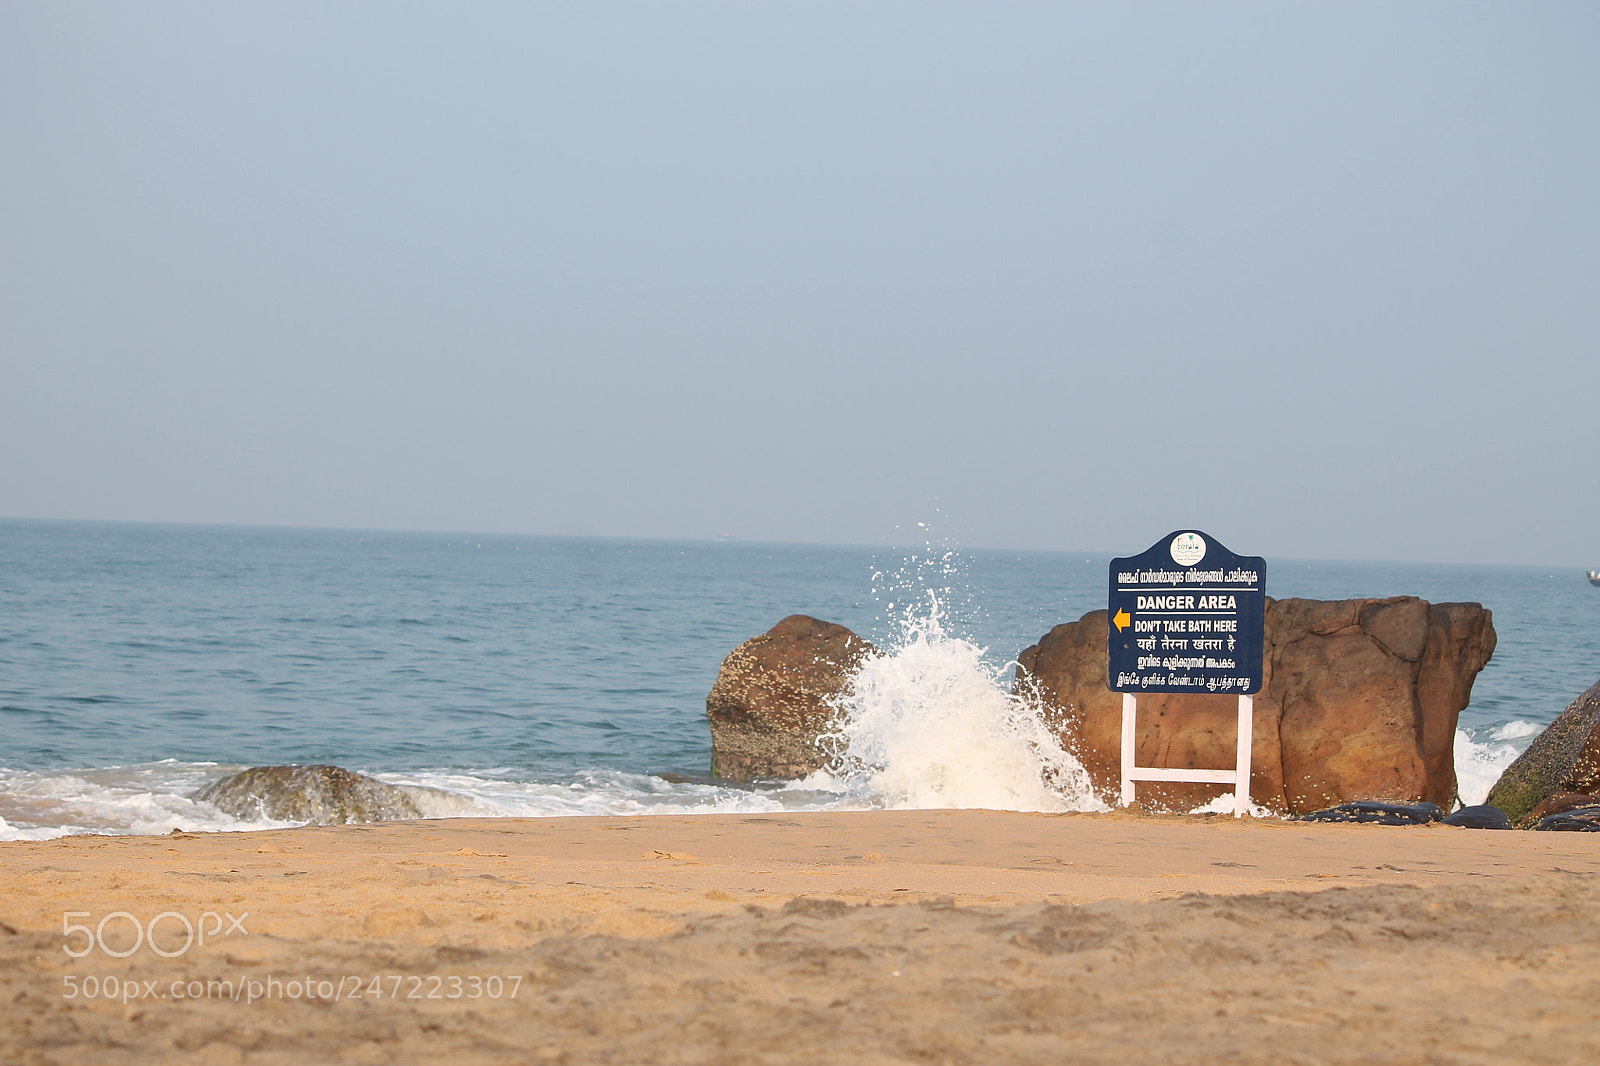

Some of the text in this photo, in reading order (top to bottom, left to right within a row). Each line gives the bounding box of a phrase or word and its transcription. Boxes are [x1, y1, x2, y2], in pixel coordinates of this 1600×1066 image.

[1137, 596, 1237, 609] DANGER AREA
[1135, 620, 1237, 632] DON'T TAKE BATH HERE
[1136, 634, 1237, 652] यहाँ तैरना खंतरा है
[1137, 654, 1161, 670] ഇവിടെ
[1206, 658, 1236, 669] അപകടം
